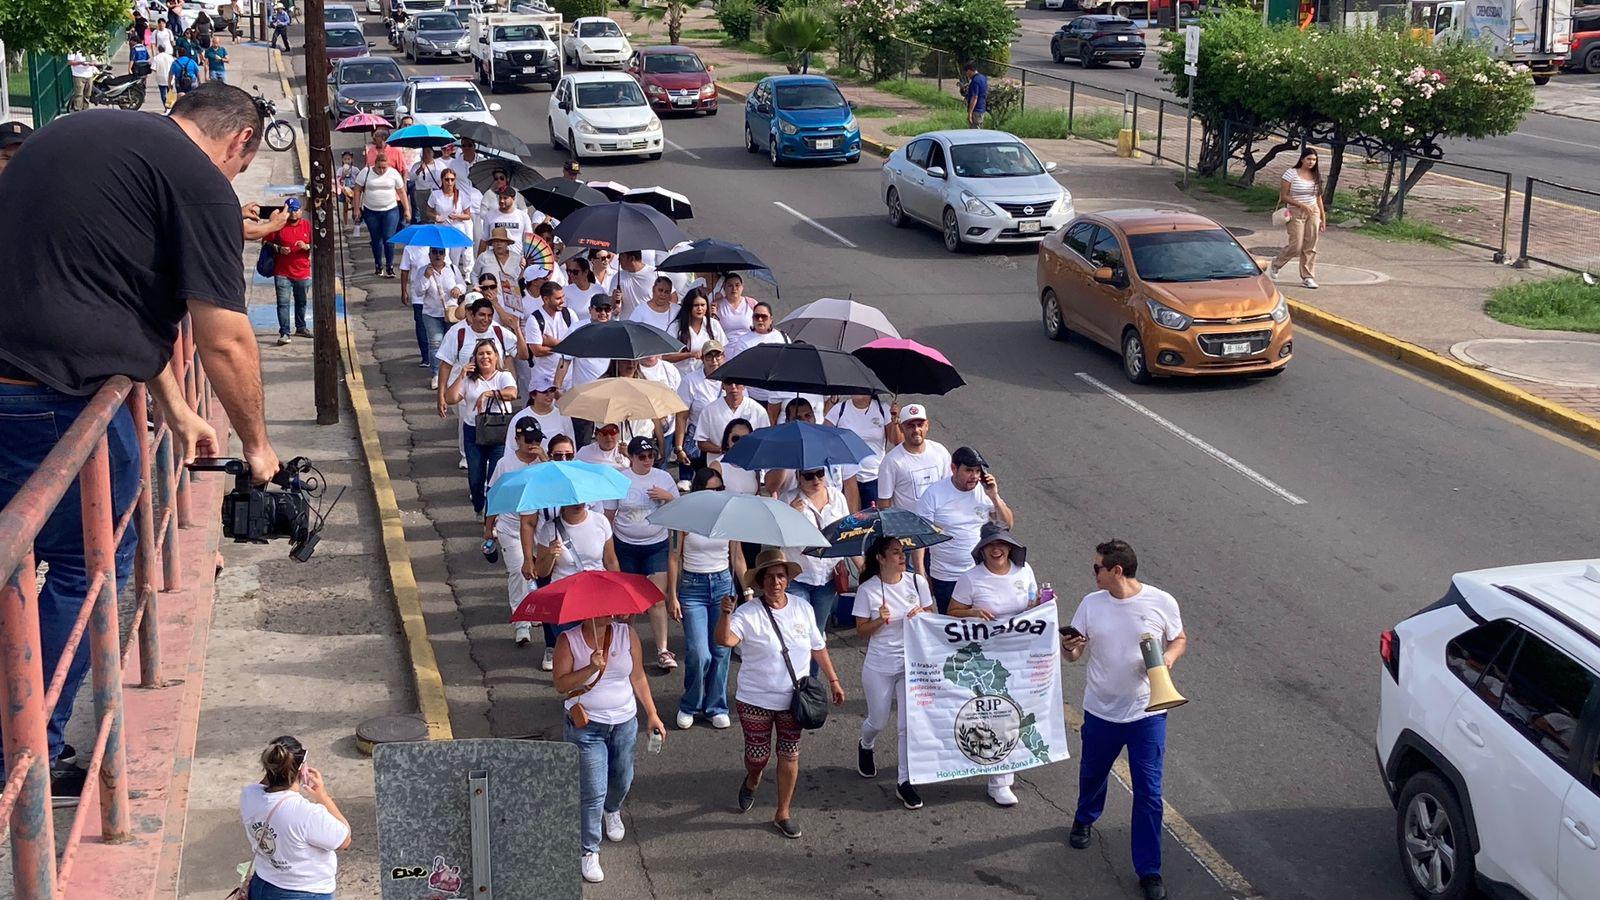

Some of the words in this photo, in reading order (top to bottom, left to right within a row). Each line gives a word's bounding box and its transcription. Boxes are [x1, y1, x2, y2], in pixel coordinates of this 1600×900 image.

[944, 617, 1047, 643] Sinaloa
[976, 699, 1002, 711] RJP
[936, 767, 969, 778] Hospital
[1000, 763, 1010, 771] de
[1010, 760, 1029, 770] Zona
